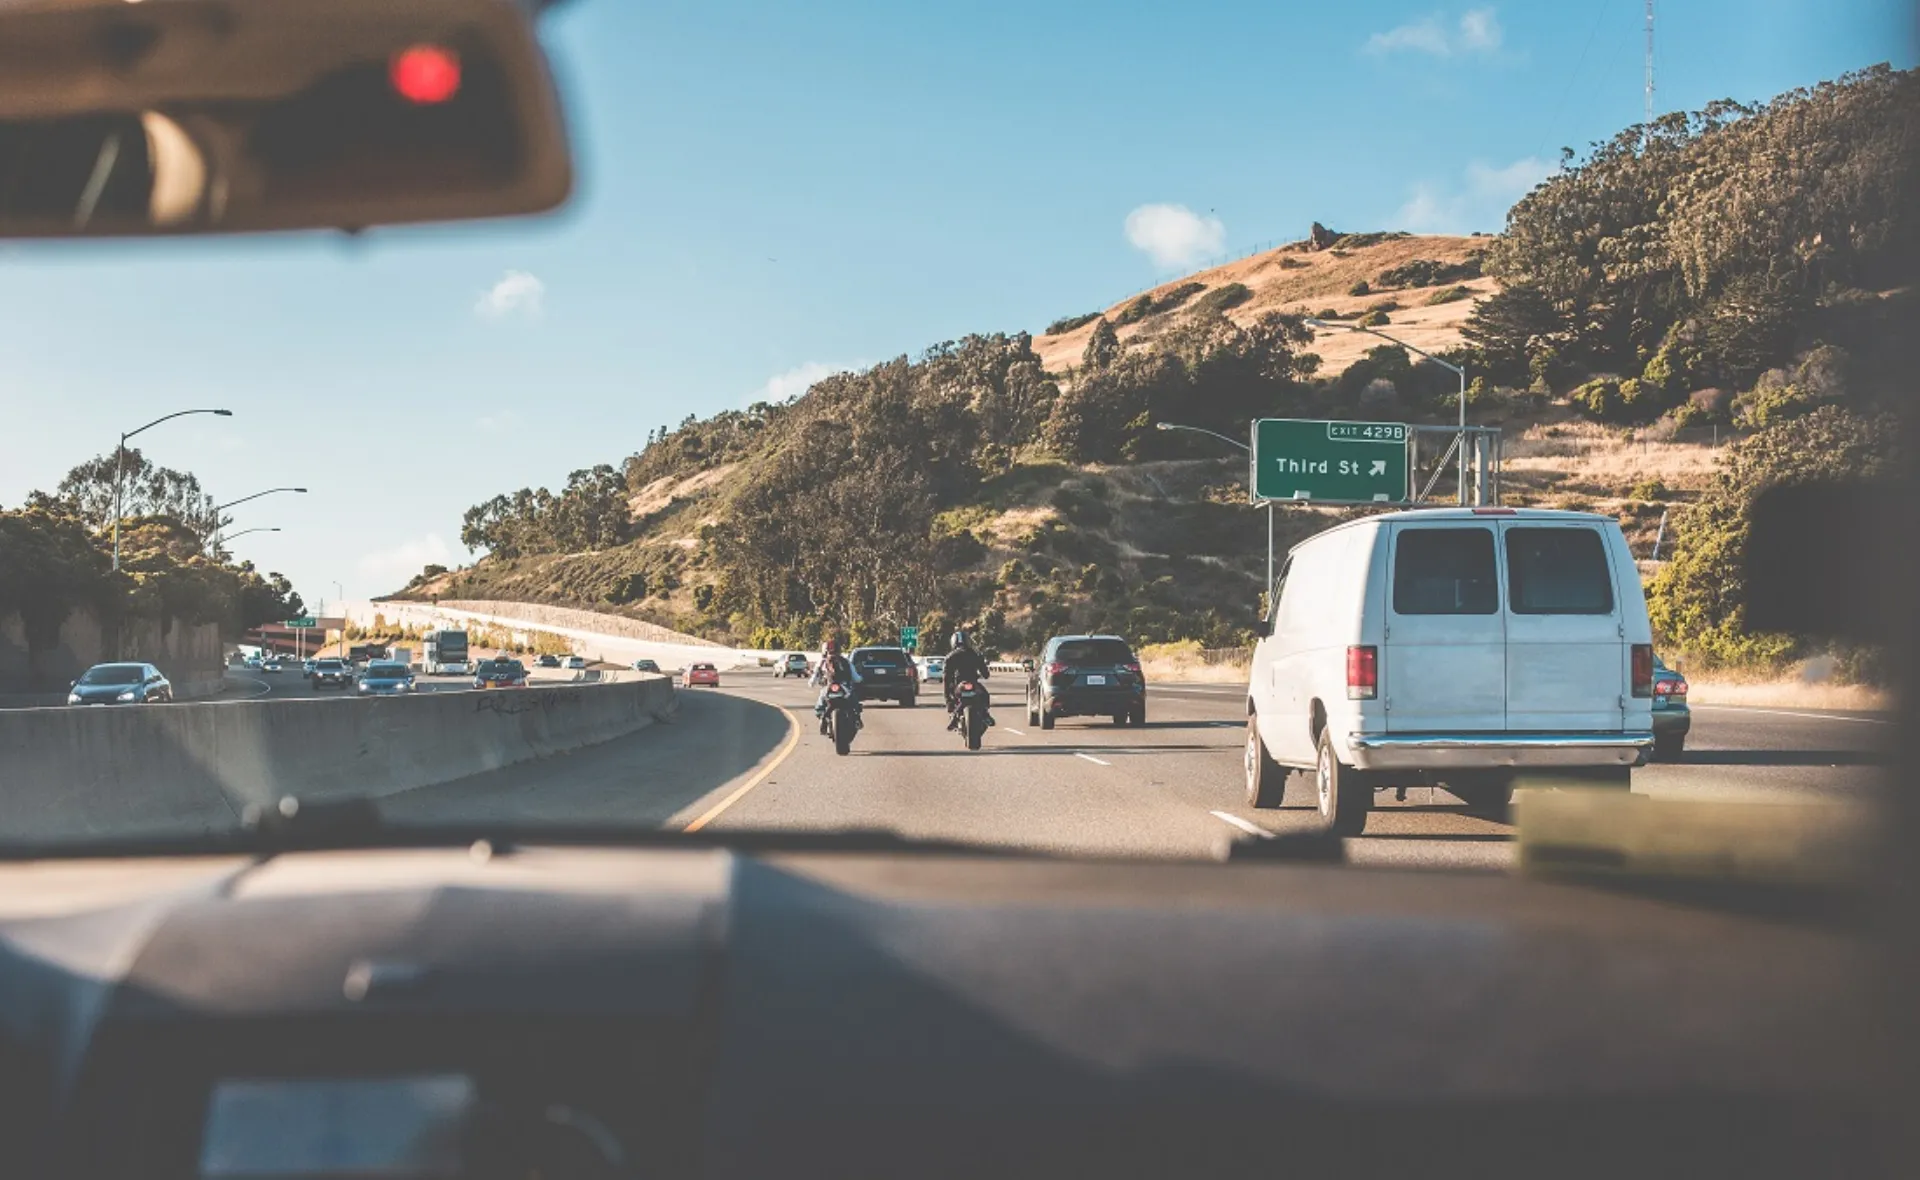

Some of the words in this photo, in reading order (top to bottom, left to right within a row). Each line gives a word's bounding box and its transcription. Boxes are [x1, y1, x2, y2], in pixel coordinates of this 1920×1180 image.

[1331, 426, 1357, 436] EXIT
[1362, 425, 1403, 439] 429B
[1276, 457, 1328, 474] Third
[1338, 459, 1359, 476] St
